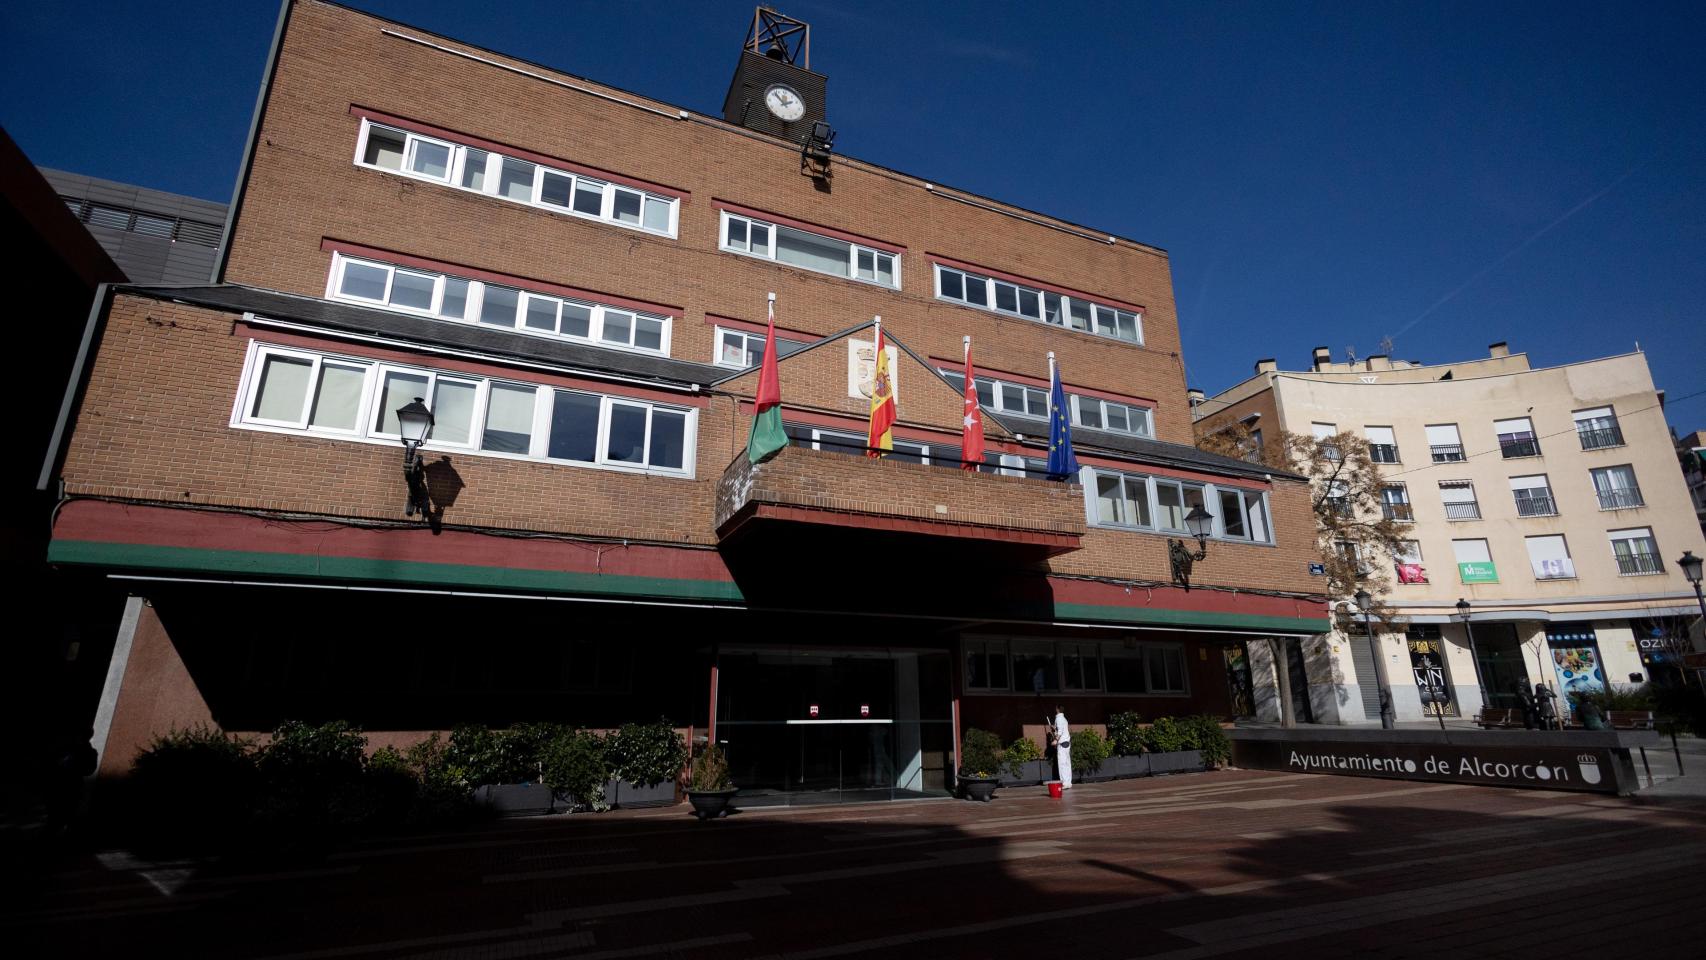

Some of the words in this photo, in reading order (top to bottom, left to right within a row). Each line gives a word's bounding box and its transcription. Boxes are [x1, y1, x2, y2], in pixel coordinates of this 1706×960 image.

[1289, 751, 1418, 778] Ayuntamiento
[1424, 755, 1450, 775] de
[1458, 756, 1569, 780] Alcorcón
